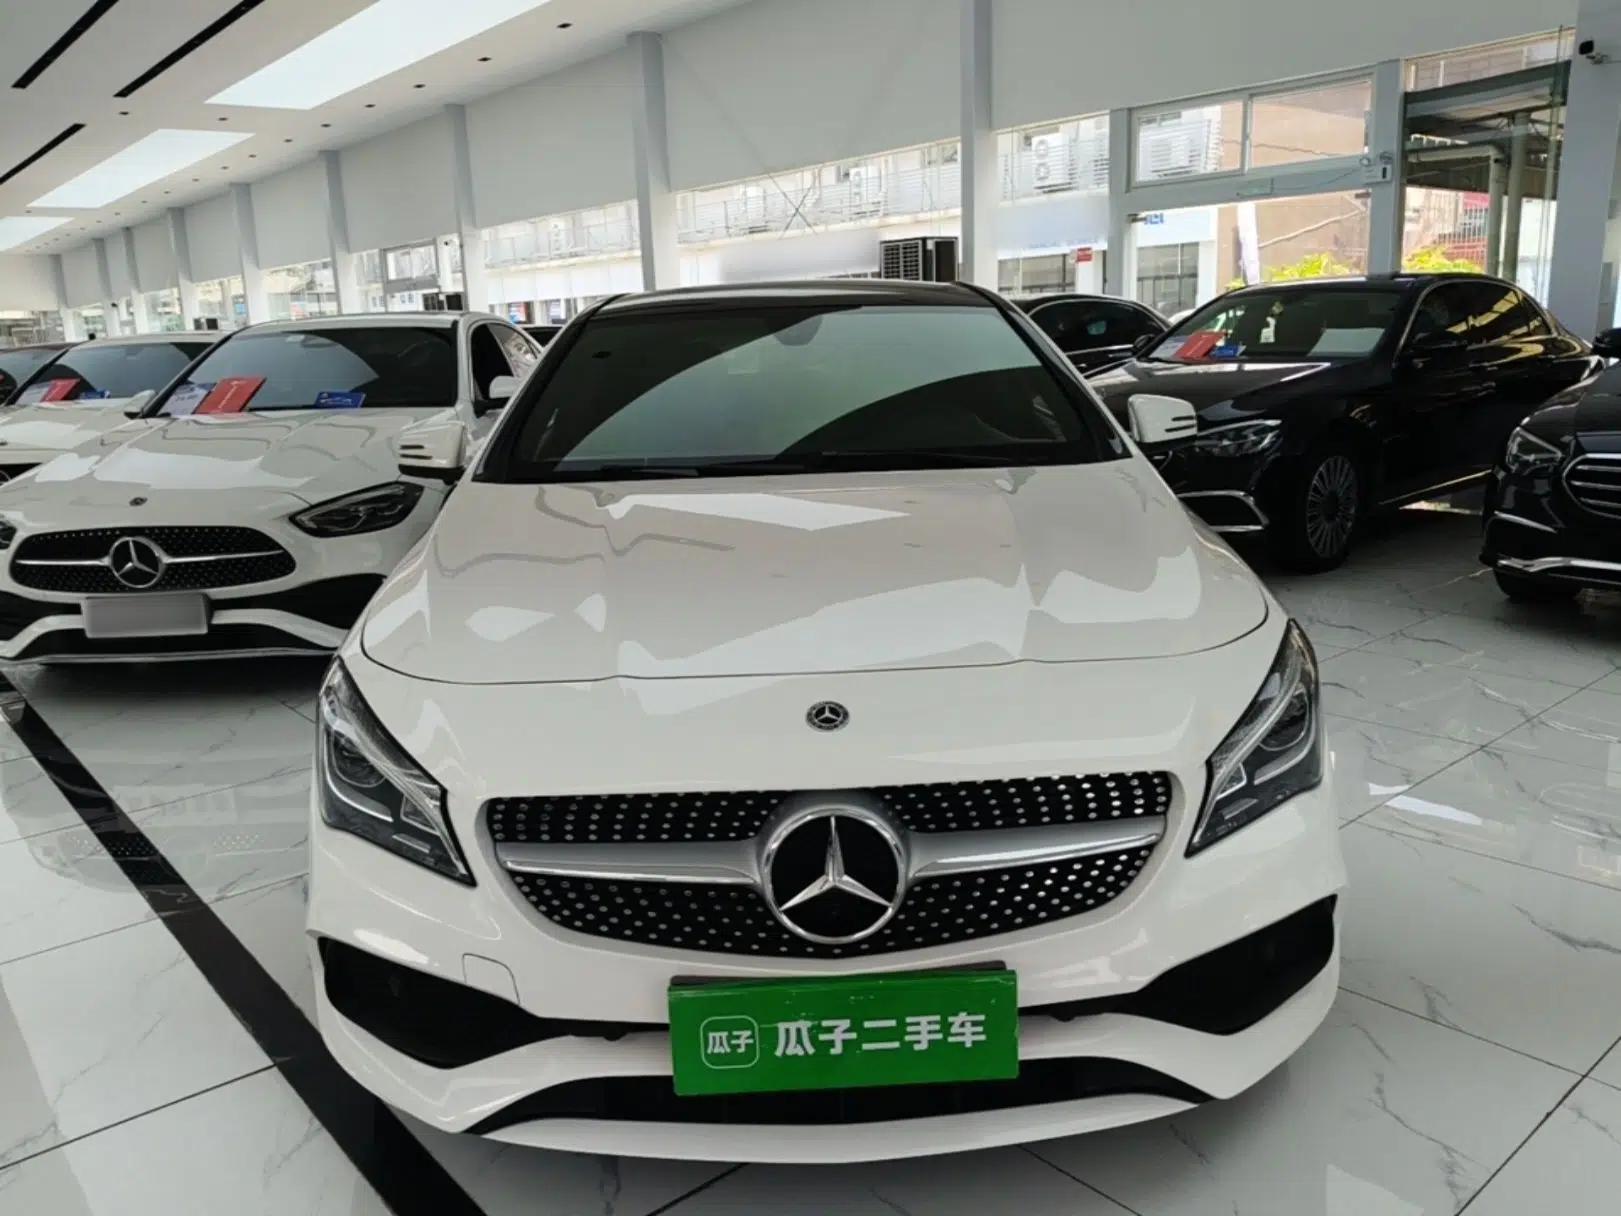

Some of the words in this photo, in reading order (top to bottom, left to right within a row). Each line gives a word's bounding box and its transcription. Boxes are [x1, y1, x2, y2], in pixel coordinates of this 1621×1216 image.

[707, 1030, 754, 1055] 瓜子
[775, 1011, 987, 1057] 瓜子二手车
